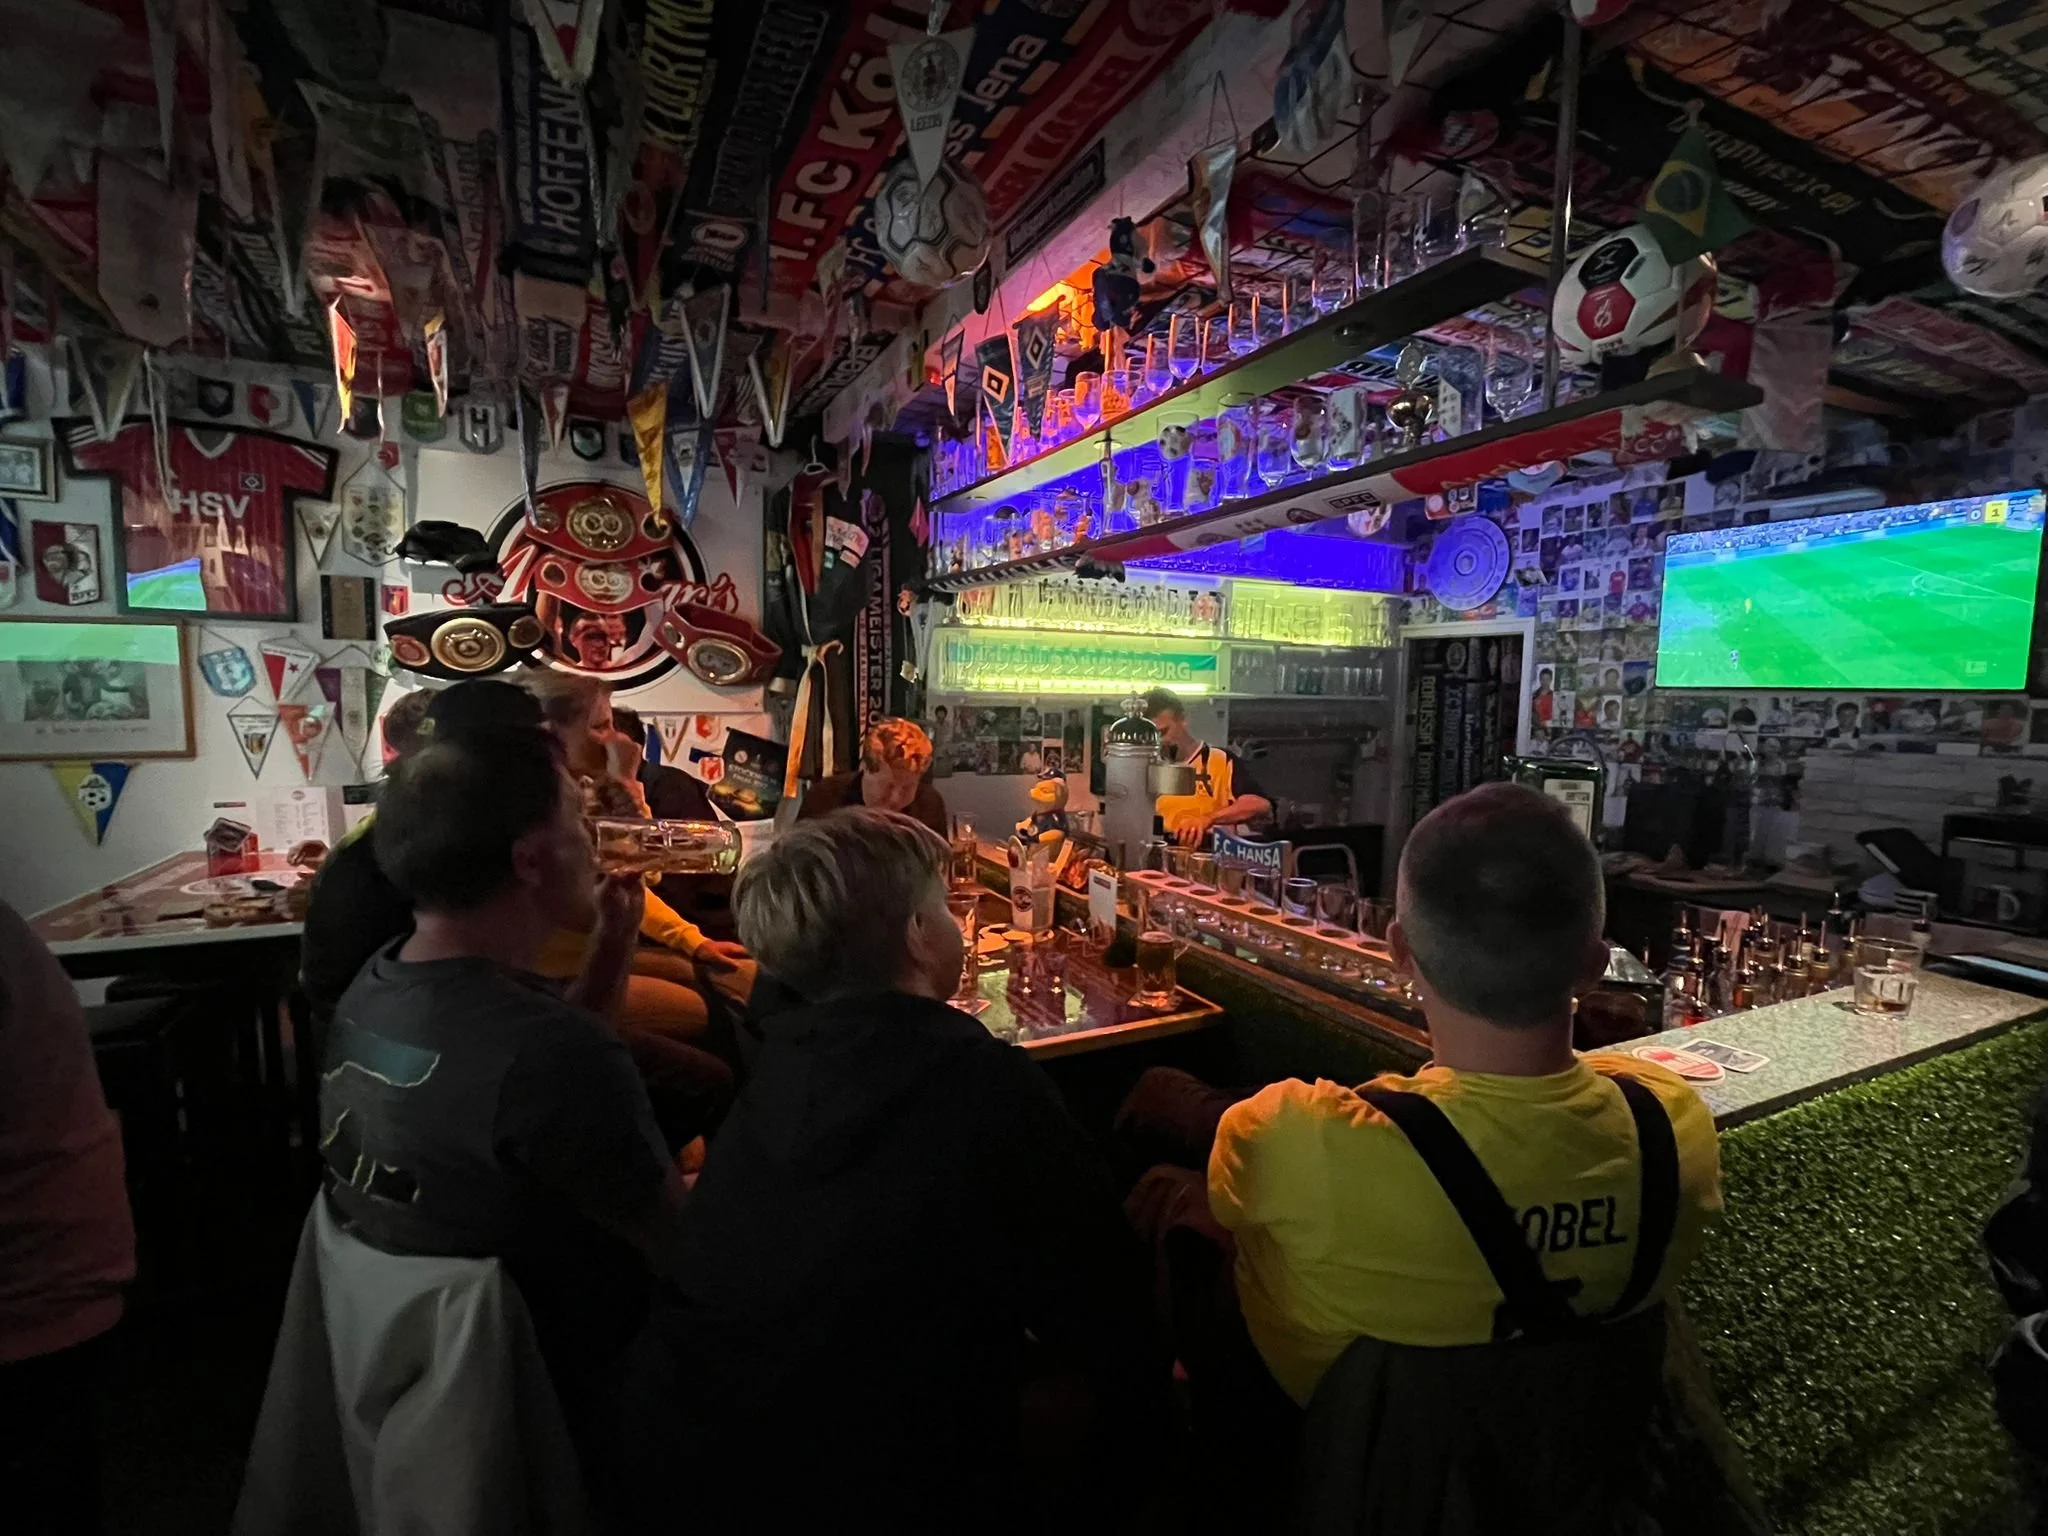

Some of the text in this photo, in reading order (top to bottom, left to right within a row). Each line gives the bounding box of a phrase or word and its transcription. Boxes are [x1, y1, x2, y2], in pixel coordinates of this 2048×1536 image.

[972, 31, 1050, 112] Jena
[171, 489, 250, 519] HSV
[868, 594, 883, 692] MEISTER
[1417, 675, 1437, 745] BORUSSIA
[1213, 832, 1281, 869] F.C. HANSA
[1511, 1196, 1629, 1252] OBEL
